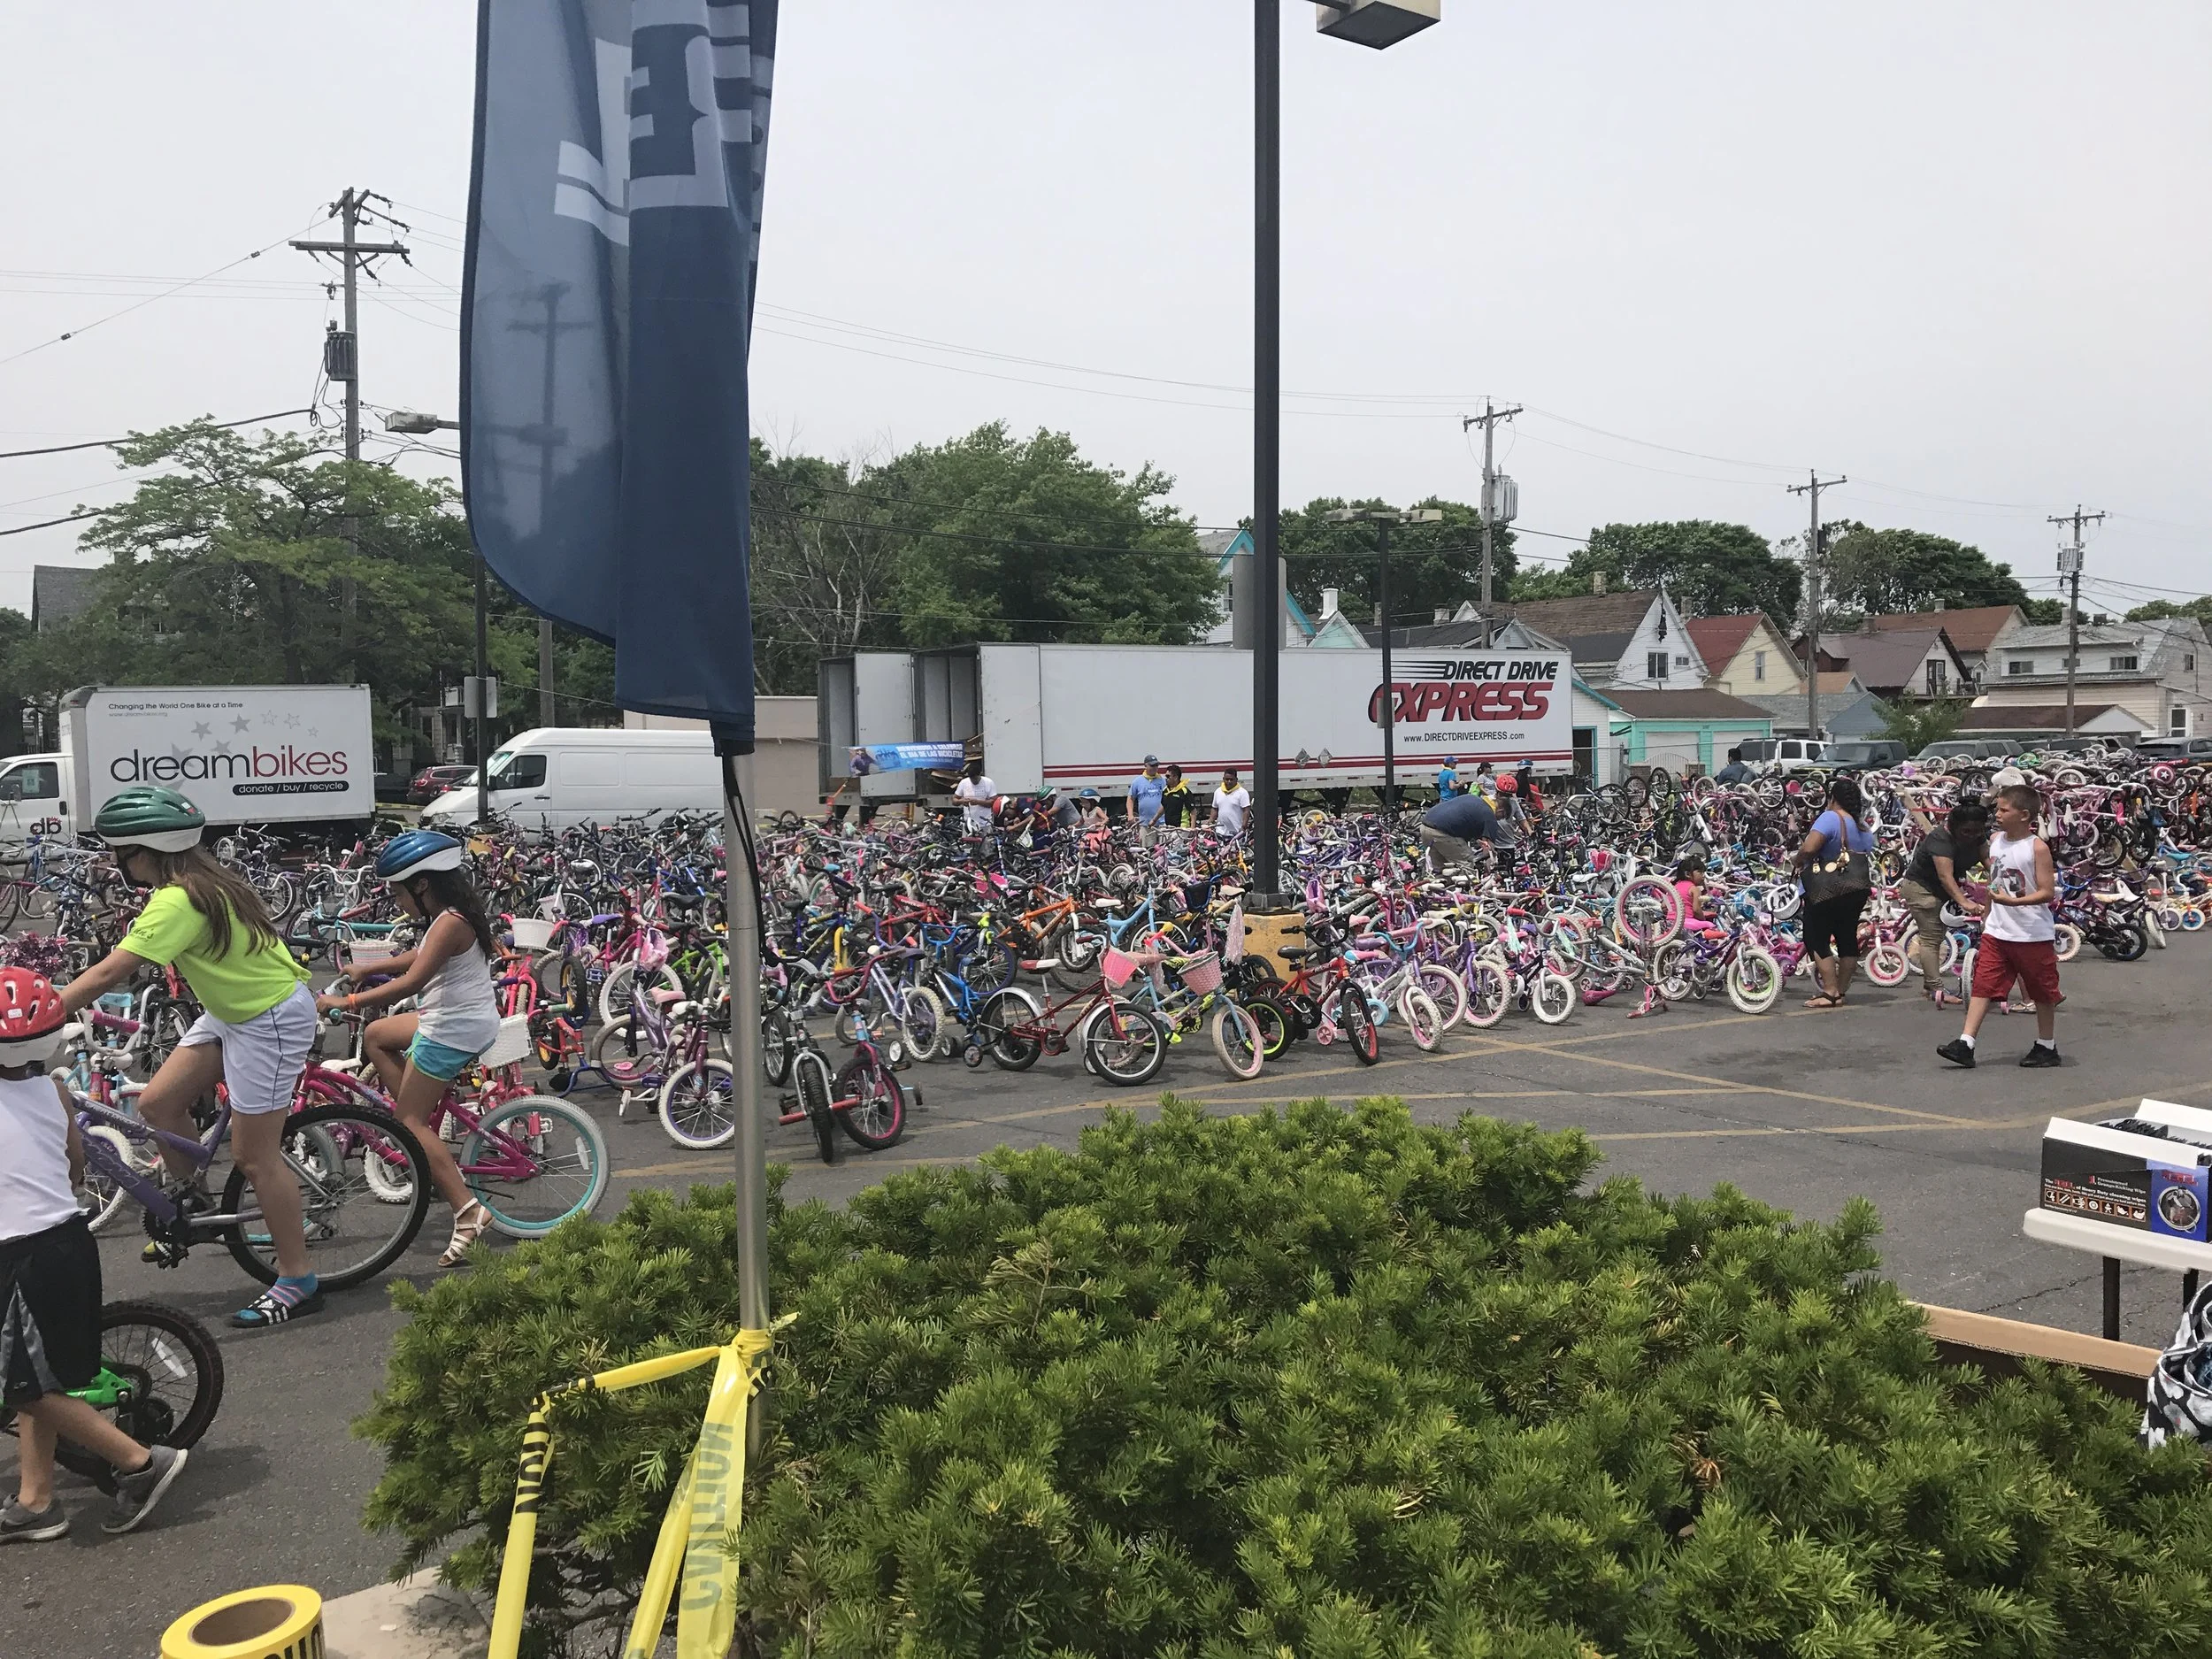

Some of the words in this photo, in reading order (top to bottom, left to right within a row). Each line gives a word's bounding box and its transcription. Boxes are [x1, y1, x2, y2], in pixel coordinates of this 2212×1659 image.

[1443, 661, 1506, 680] DIRECT
[1507, 661, 1559, 680] DRIVE
[111, 745, 348, 781] dreambikes
[283, 783, 301, 792] buy
[309, 782, 343, 791] recycle
[30, 818, 62, 834] db
